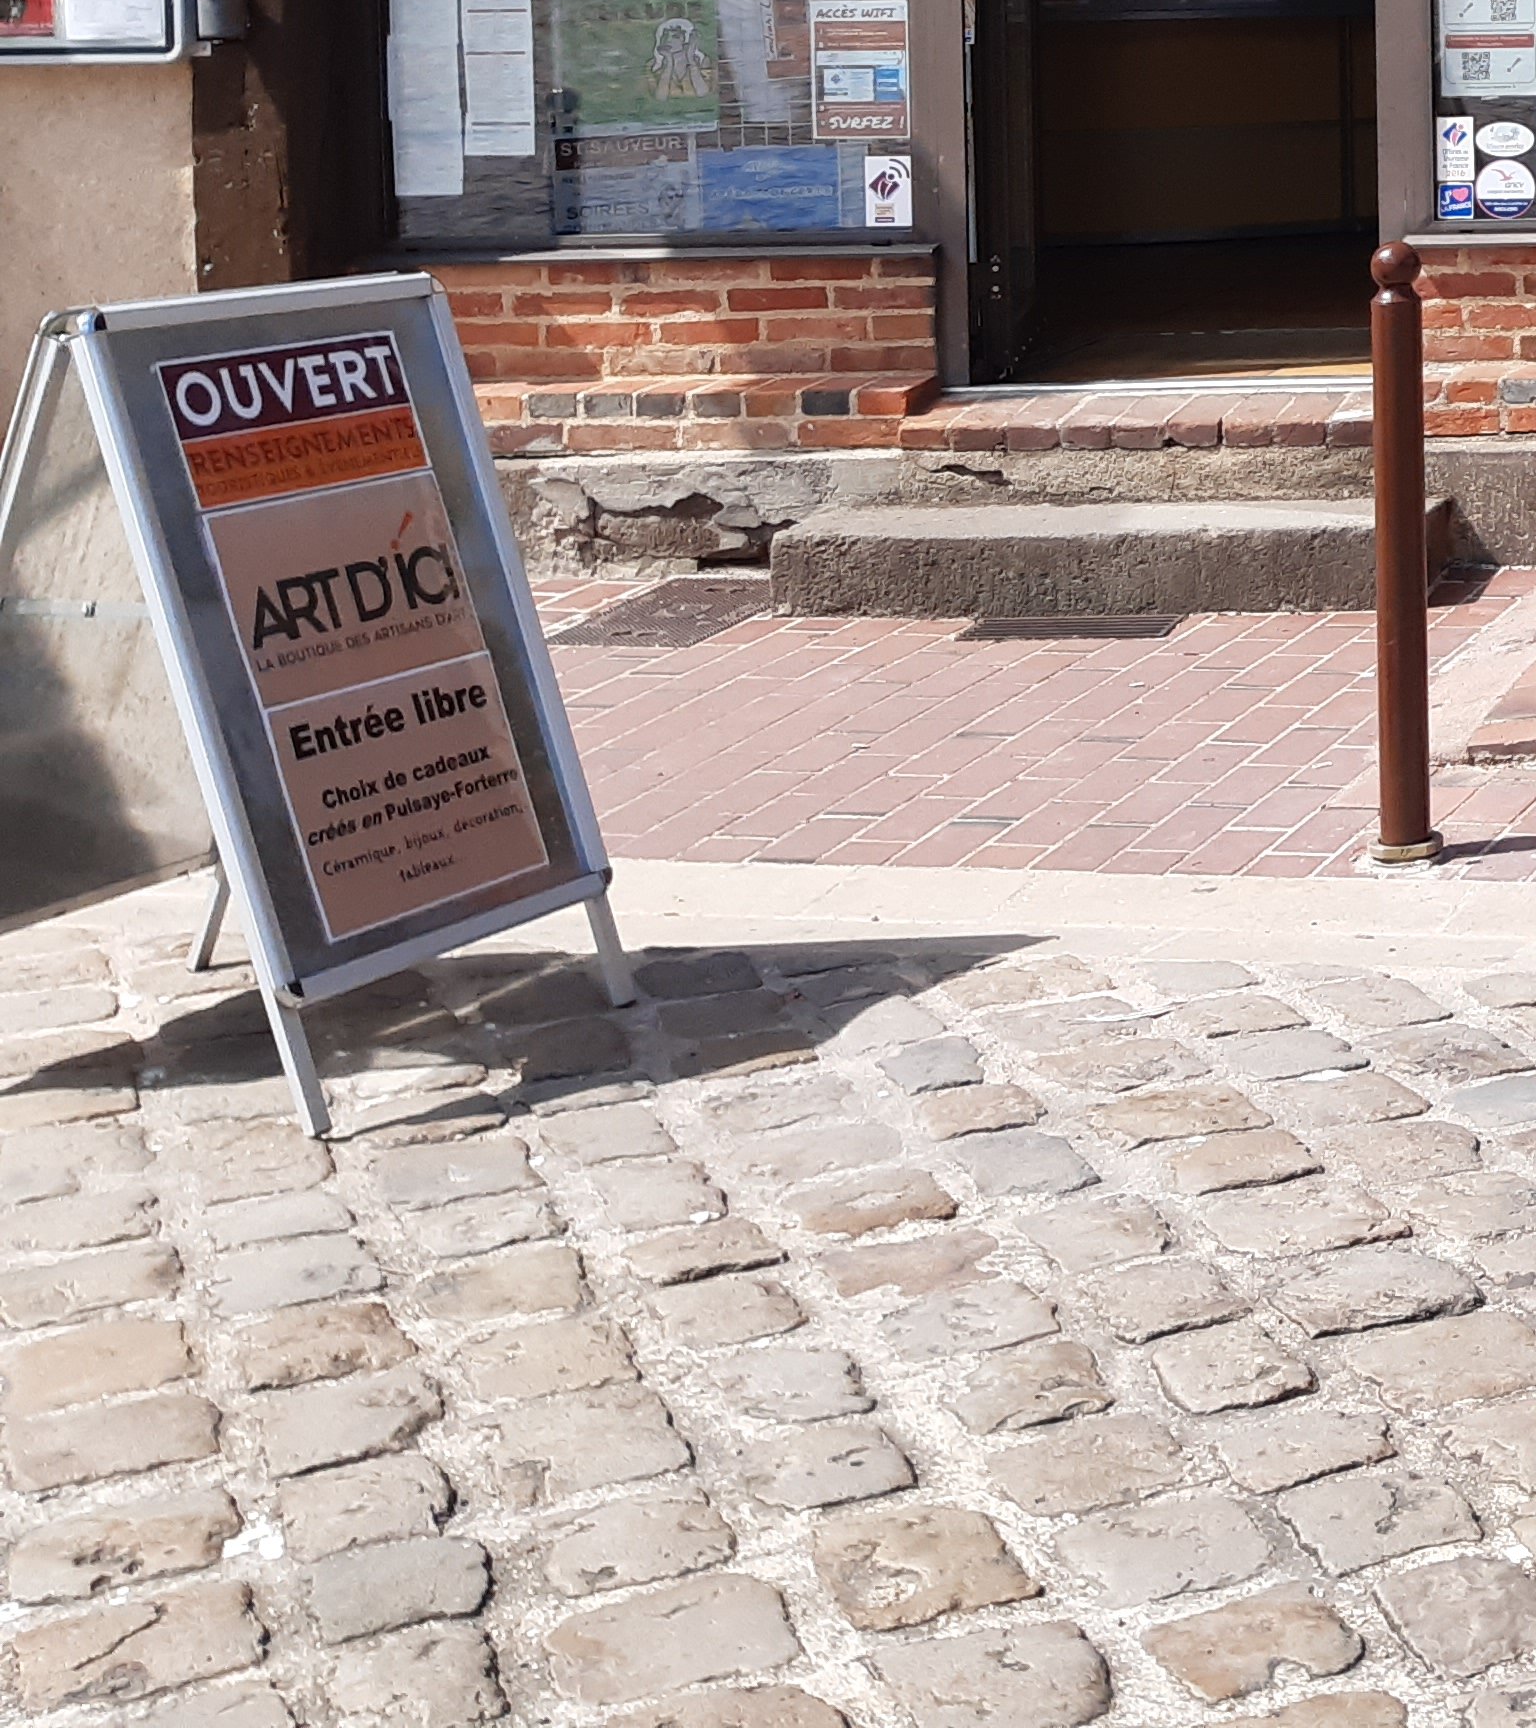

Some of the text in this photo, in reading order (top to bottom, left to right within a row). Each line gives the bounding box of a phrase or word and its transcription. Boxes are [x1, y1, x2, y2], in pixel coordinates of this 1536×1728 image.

[815, 5, 897, 19] ACCÈS WIFI
[829, 115, 894, 130] SURFEZ
[175, 344, 394, 427] OUVERT
[191, 417, 417, 475] RENSEIGNEMENTS
[252, 567, 342, 650] ART
[255, 658, 276, 672] LA
[279, 640, 344, 669] BOUTIQUE
[346, 632, 371, 649] DES
[374, 615, 433, 642] ARTISANS
[288, 683, 489, 761] Entrée libre
[322, 744, 493, 810] Choix de cadeaux
[362, 810, 383, 830] en
